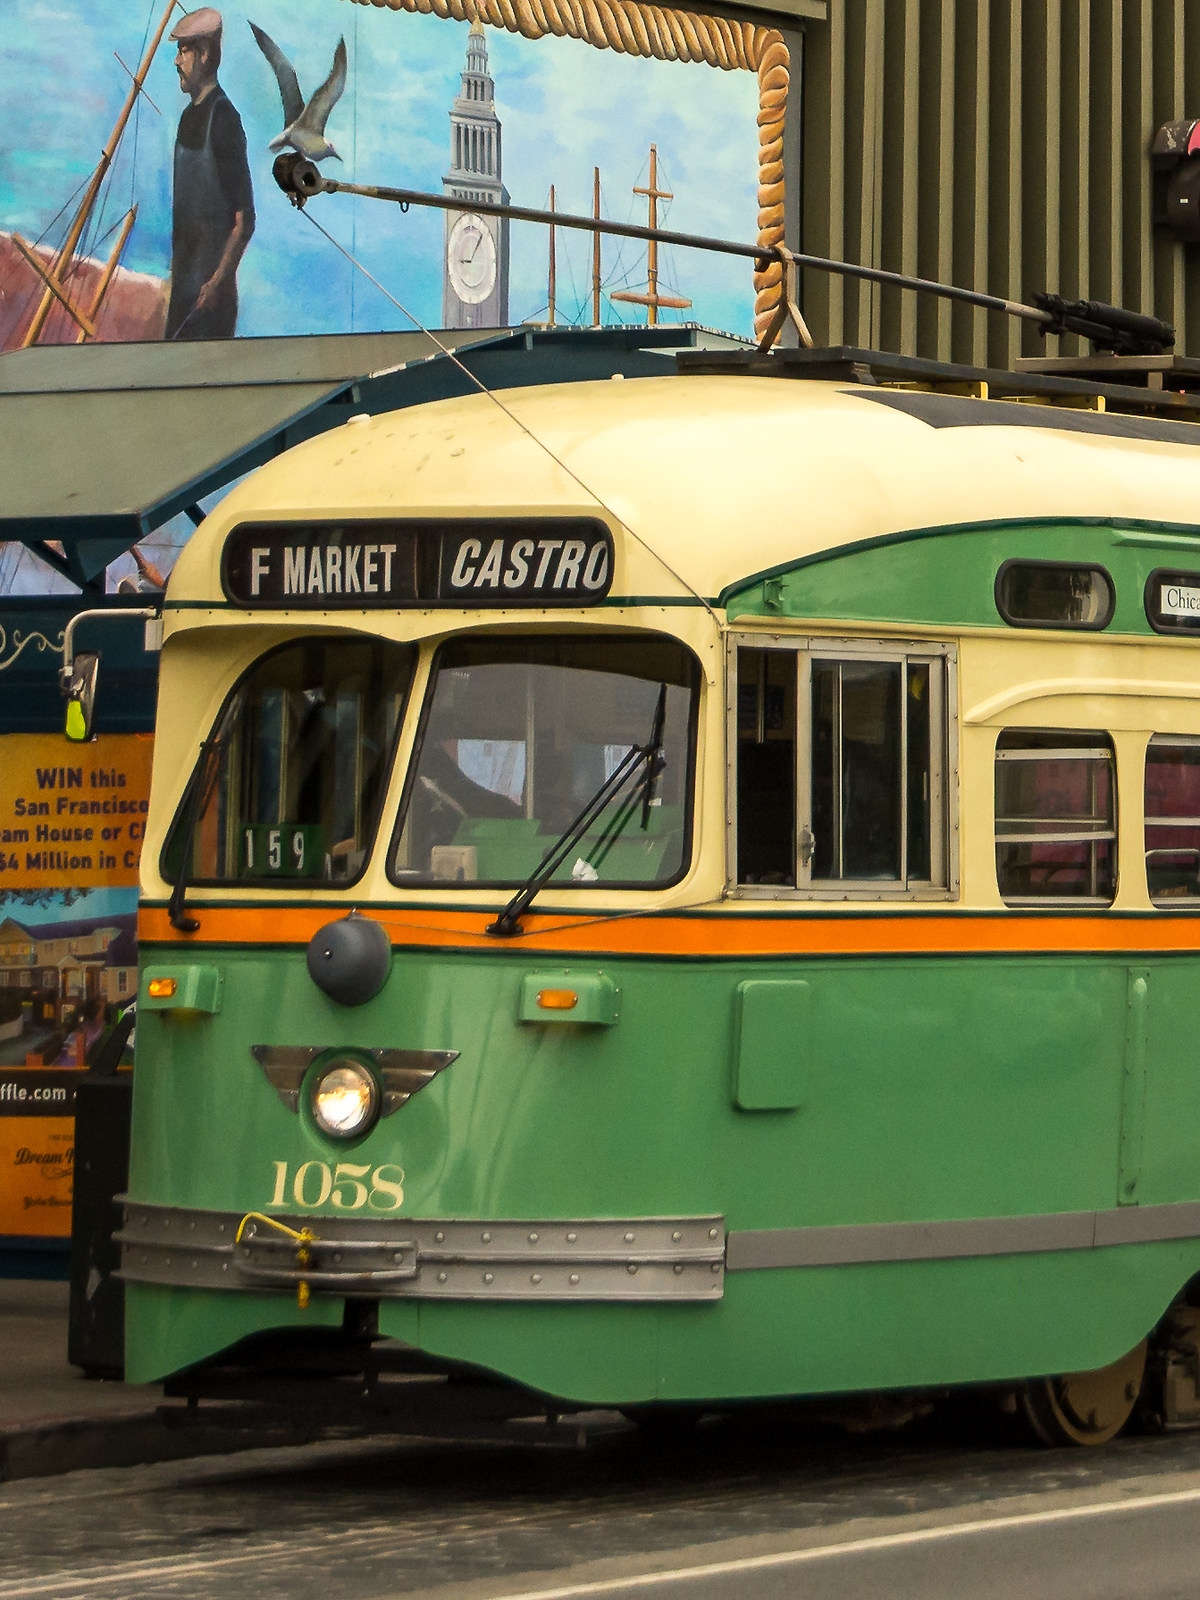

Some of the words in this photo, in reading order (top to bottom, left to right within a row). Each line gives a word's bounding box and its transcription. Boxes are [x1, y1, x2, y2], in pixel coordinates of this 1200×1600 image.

[251, 547, 271, 595] F
[283, 544, 397, 595] MARKET
[451, 538, 609, 590] CASTRO
[36, 768, 83, 789] WIN
[90, 768, 127, 788] this
[14, 798, 50, 816] San
[56, 795, 149, 815] Francisco
[36, 824, 94, 842] House
[101, 826, 122, 841] or
[245, 829, 305, 870] 159
[26, 851, 92, 870] Million
[100, 851, 117, 869] in
[13, 1147, 64, 1166] Dream
[265, 1160, 405, 1211] 1058
